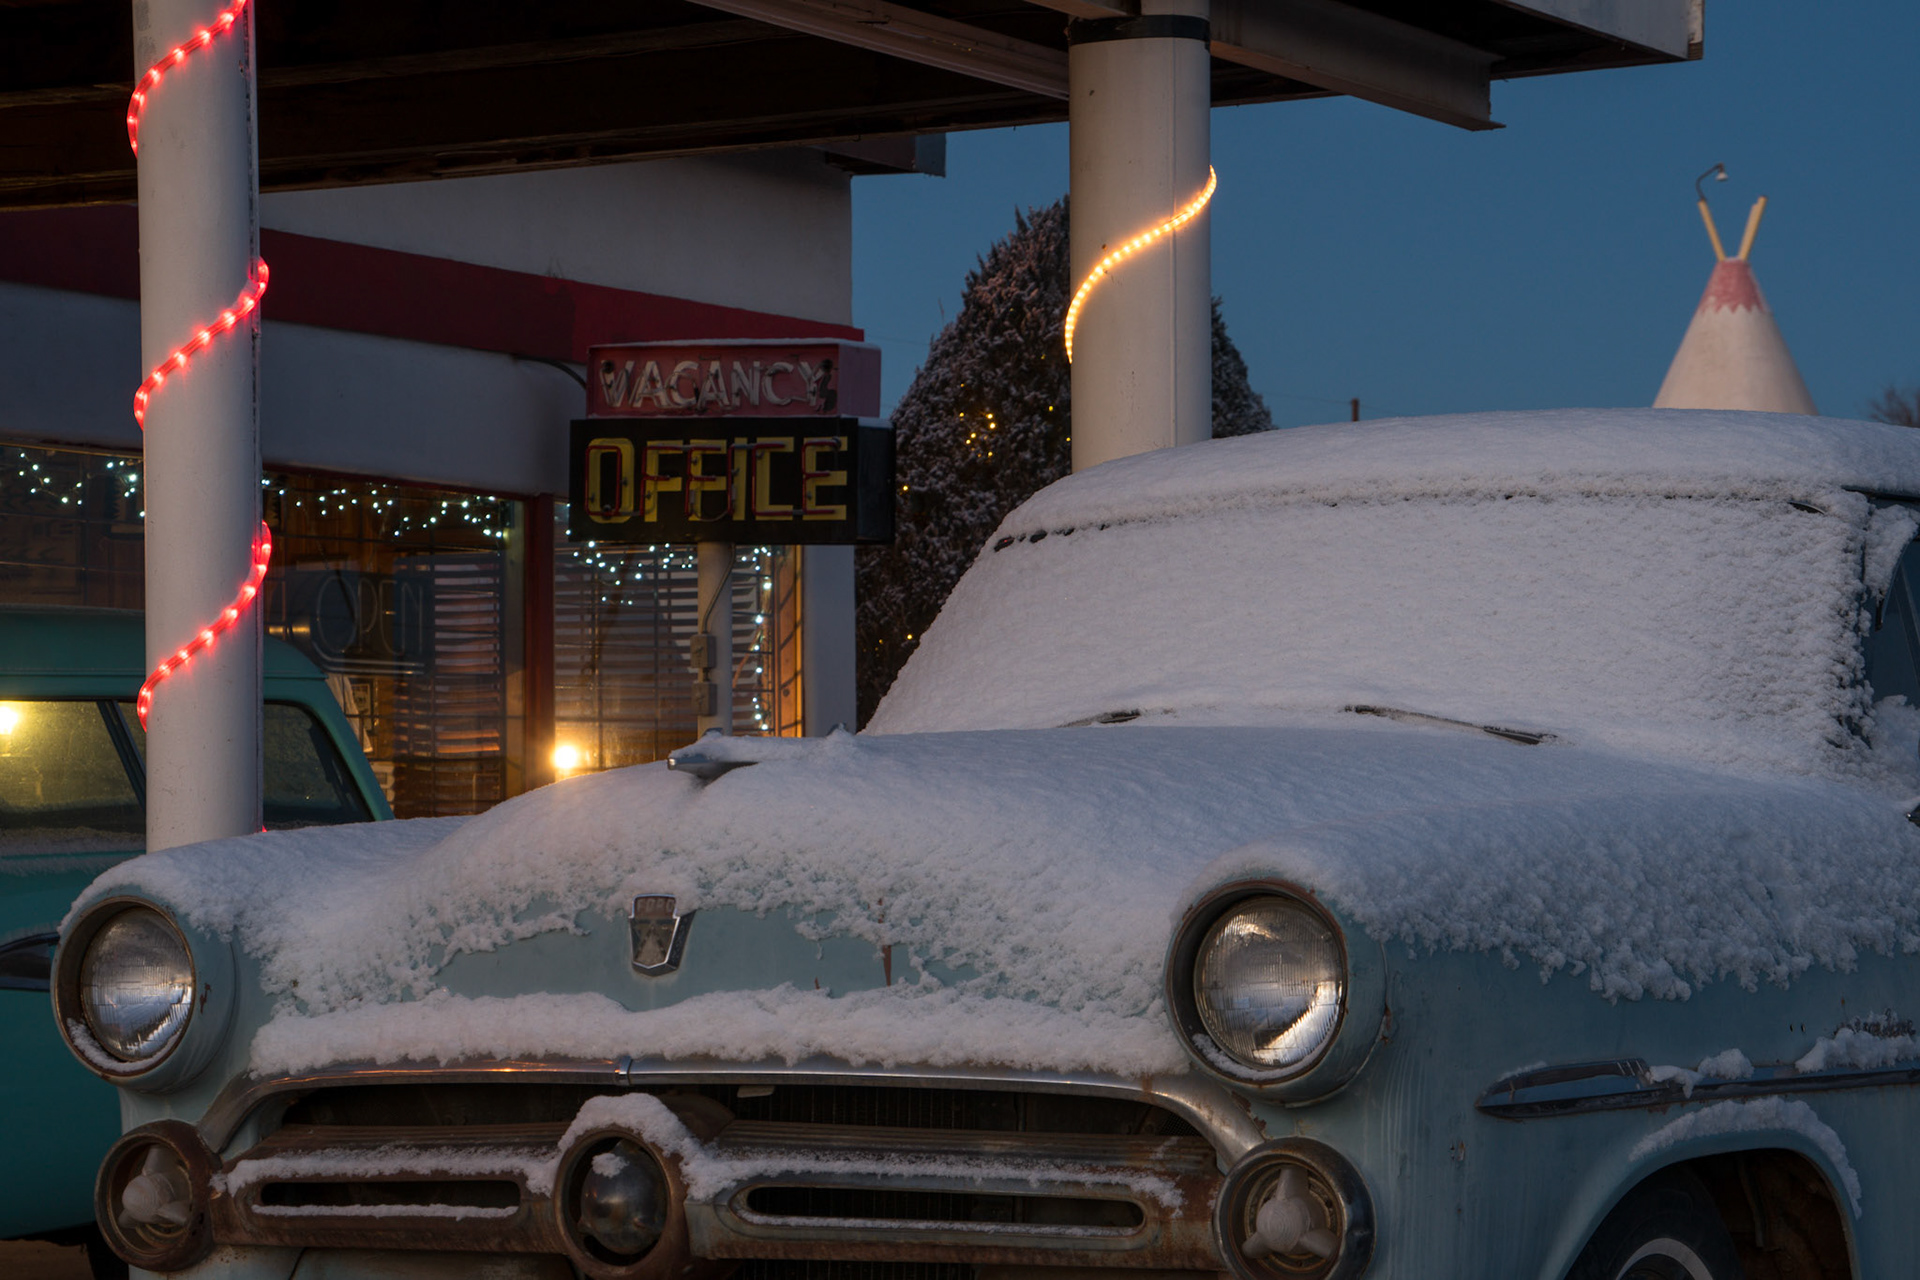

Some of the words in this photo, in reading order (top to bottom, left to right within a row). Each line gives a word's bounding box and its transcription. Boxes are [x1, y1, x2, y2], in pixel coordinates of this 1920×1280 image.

[600, 360, 829, 409] VACANCY
[585, 436, 849, 523] OFFICE
[317, 575, 424, 656] OPEN
[636, 897, 676, 912] FORD
